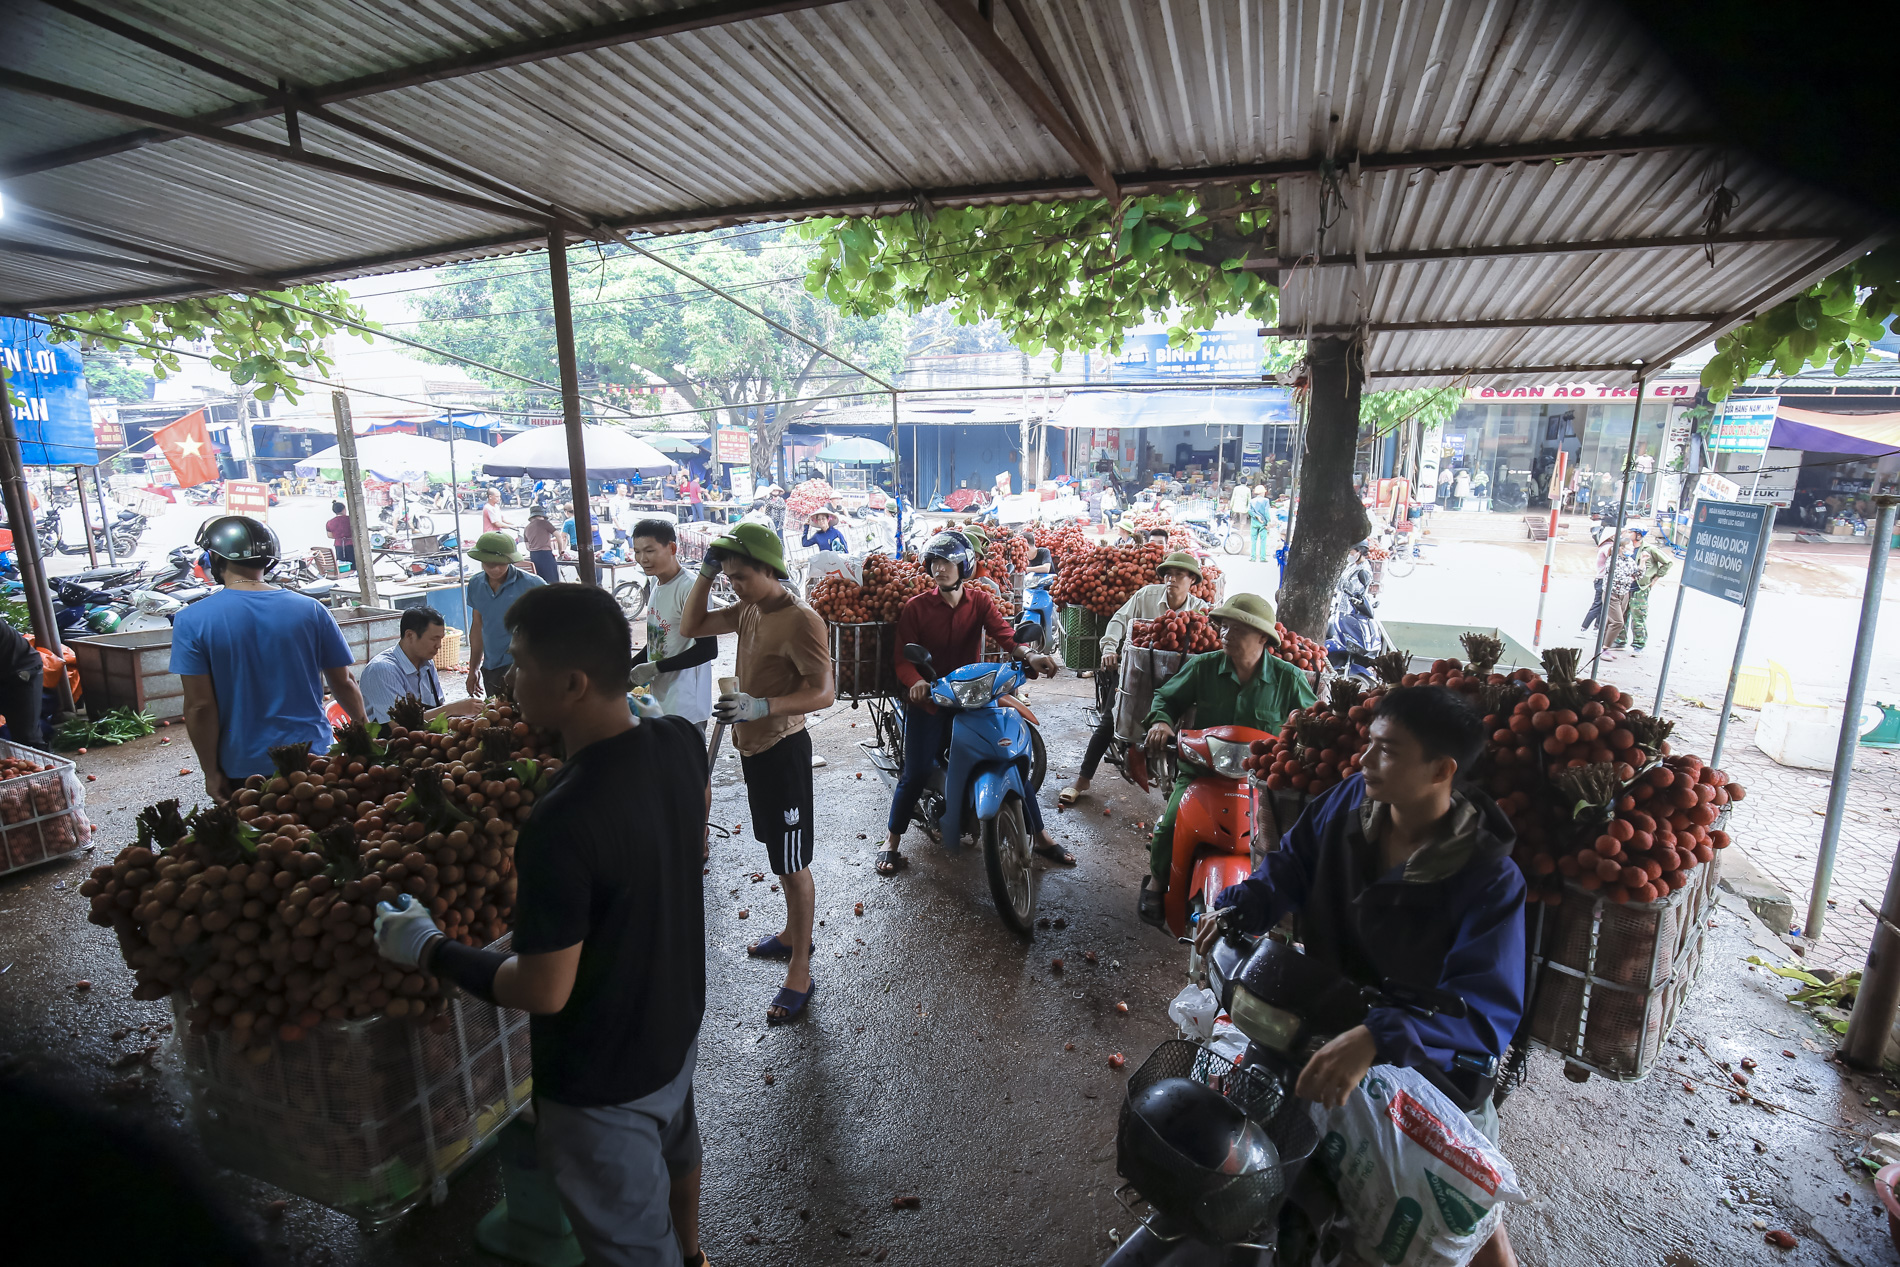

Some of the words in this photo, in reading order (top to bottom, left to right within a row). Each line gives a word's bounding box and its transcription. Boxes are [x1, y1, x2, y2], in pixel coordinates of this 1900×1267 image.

[25, 348, 58, 379] LỢI
[1655, 386, 1689, 397] EM
[1711, 535, 1730, 551] GIAO
[1730, 538, 1749, 555] DỊCH
